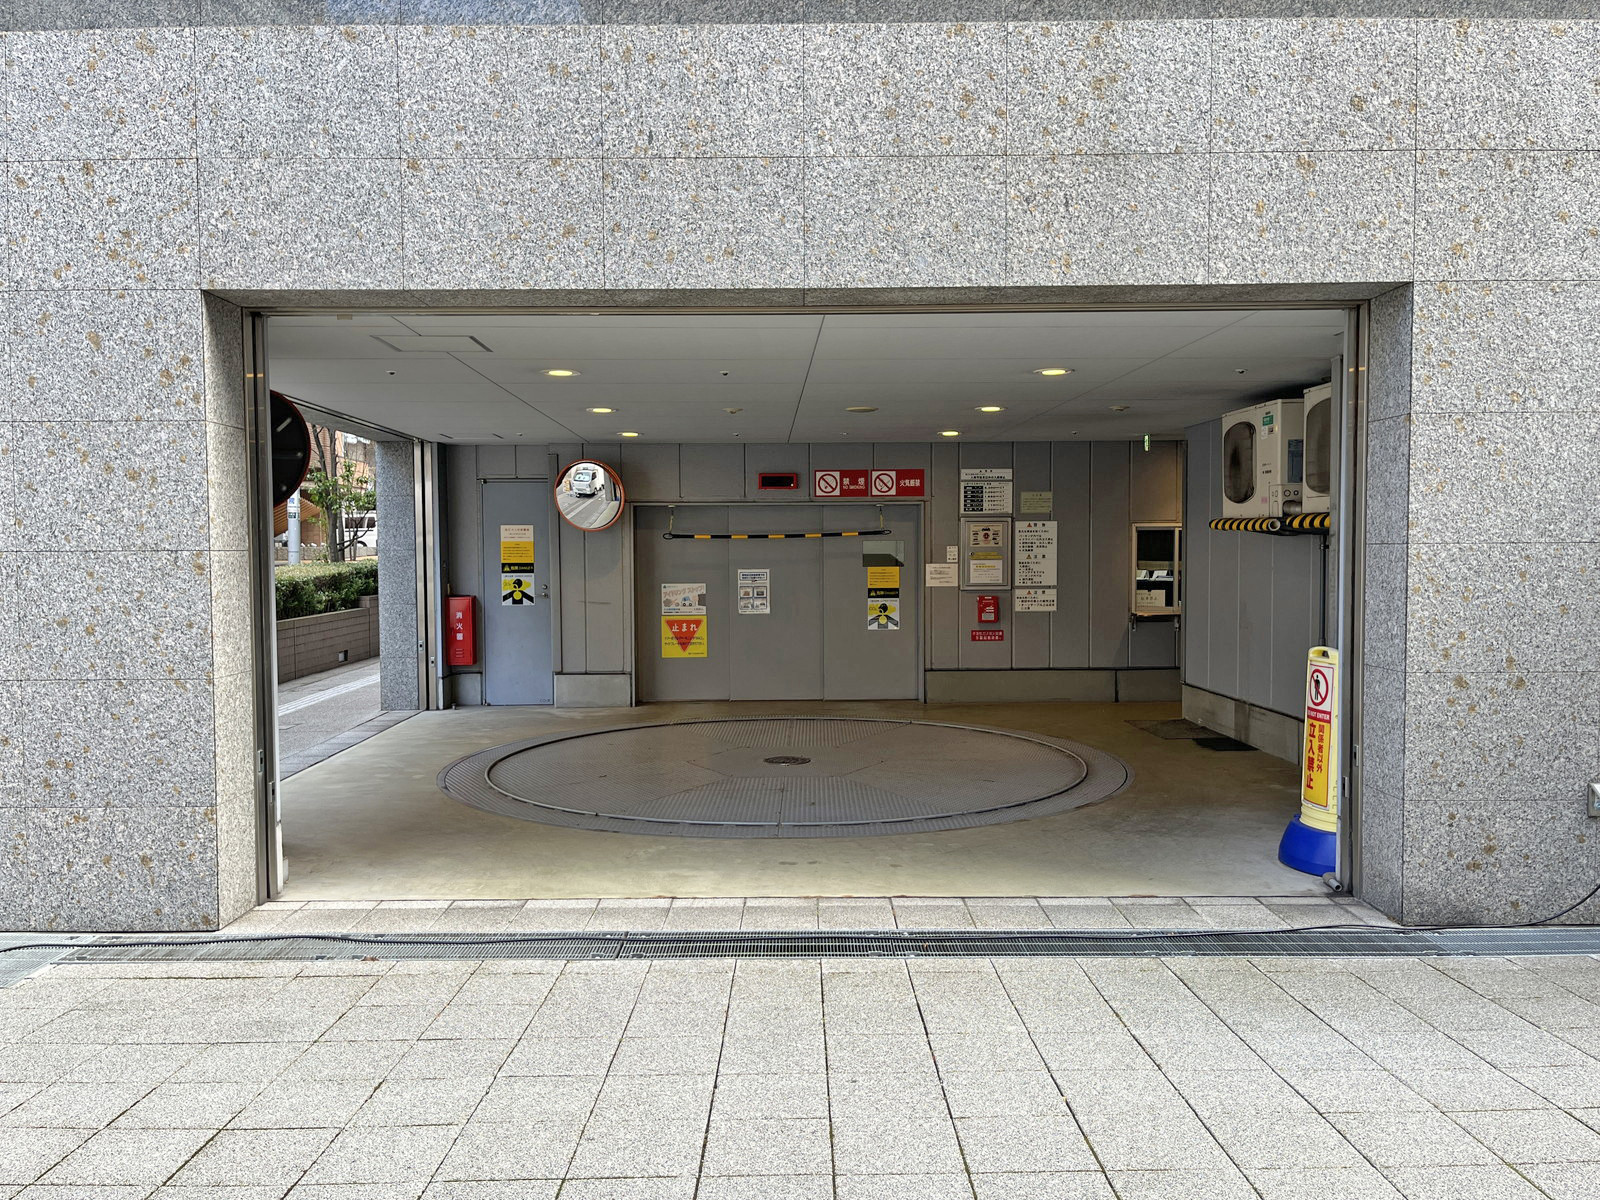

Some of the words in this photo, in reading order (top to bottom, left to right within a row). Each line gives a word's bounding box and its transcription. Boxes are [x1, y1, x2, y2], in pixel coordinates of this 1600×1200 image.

[899, 479, 921, 487] 火気厳禁
[455, 611, 464, 641] 消火器
[671, 622, 698, 633] 止まれ
[1316, 711, 1330, 720] ENTER
[1306, 721, 1317, 790] 立入禁止
[1316, 723, 1325, 774] 関係者以外
